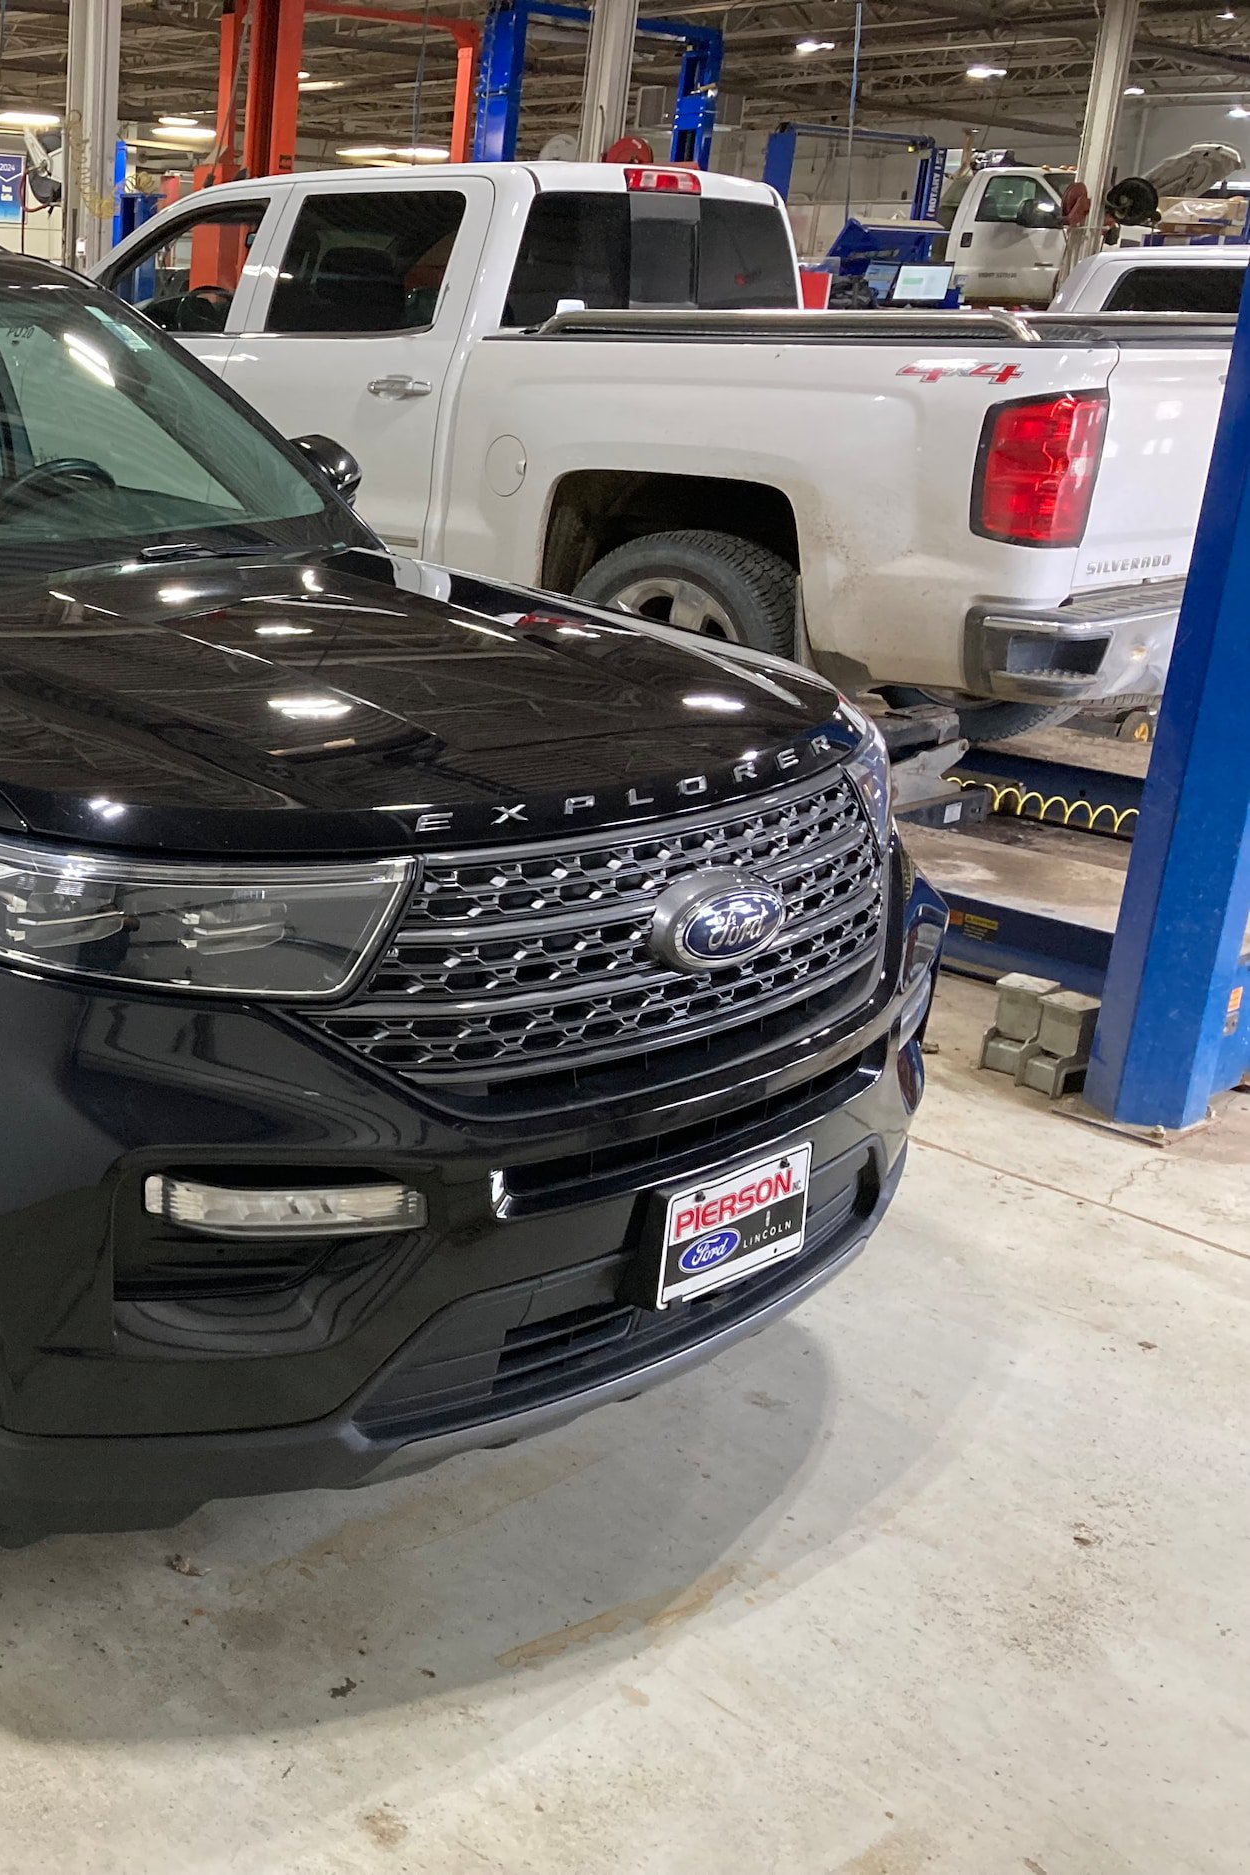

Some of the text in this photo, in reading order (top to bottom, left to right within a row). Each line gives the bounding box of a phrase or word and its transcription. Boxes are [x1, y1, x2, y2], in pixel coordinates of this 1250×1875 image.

[0, 162, 16, 172] 2024
[1086, 554, 1172, 575] SILVERADO
[415, 734, 832, 833] EXPLORER
[707, 900, 770, 952] Ford
[674, 1168, 793, 1241] PIERSON
[742, 1219, 792, 1249] LINCOLN
[690, 1235, 731, 1266] Ford
